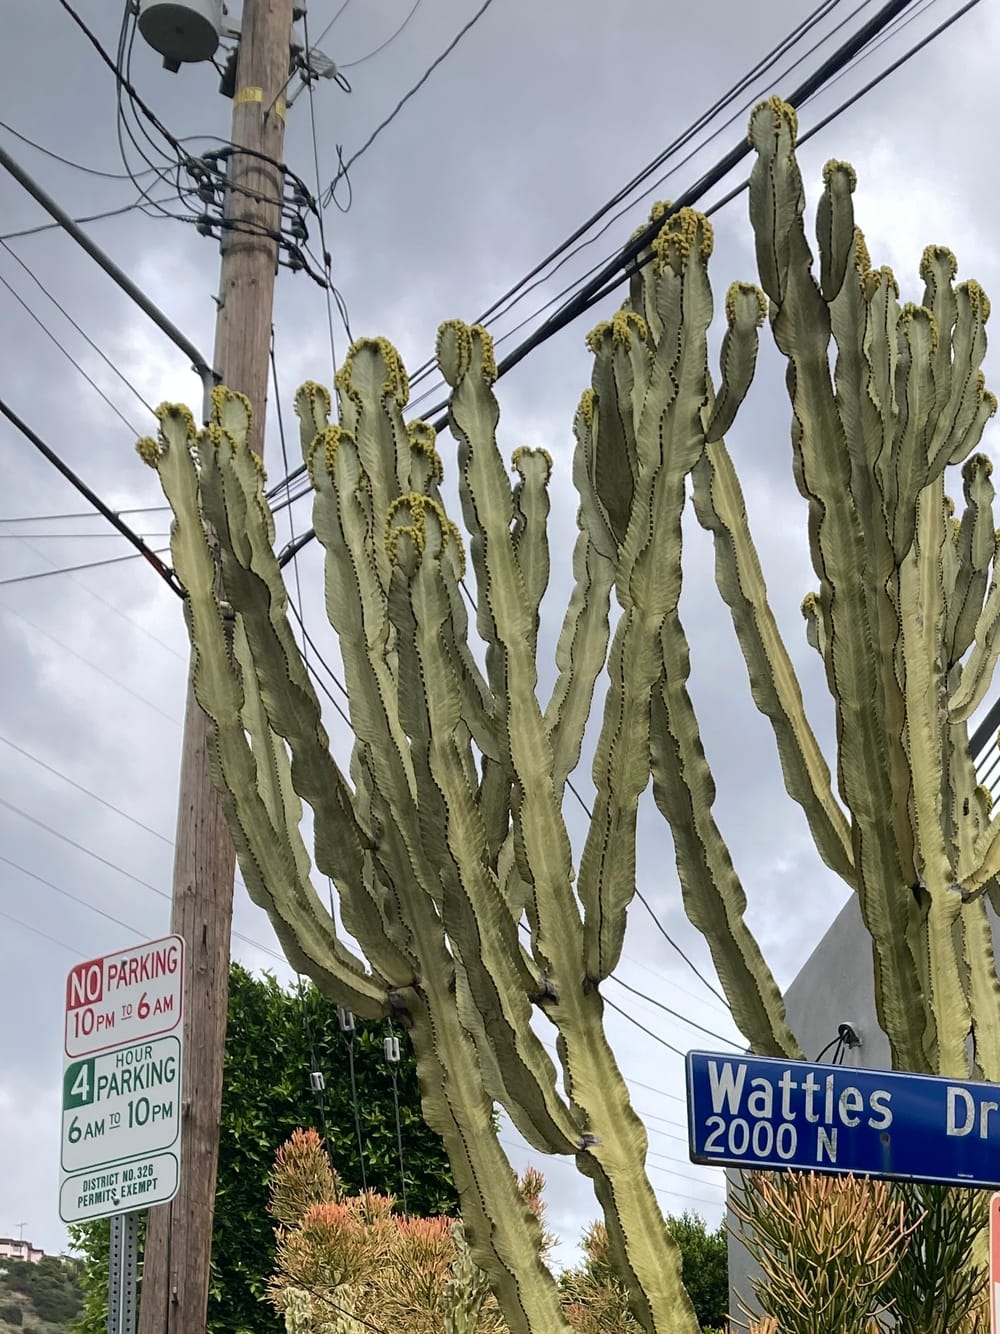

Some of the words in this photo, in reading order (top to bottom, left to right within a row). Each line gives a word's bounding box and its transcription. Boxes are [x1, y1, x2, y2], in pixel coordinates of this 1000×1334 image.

[71, 965, 101, 1006] NO
[107, 946, 177, 992] PARKING
[121, 1003, 133, 1020] TO
[115, 1045, 153, 1069] HOUR
[70, 1063, 90, 1101] 4
[97, 1056, 176, 1102] PARKING
[707, 1060, 894, 1130] Wattles
[946, 1086, 999, 1139] Dr
[109, 1112, 121, 1130] TO
[703, 1115, 798, 1160] 2000
[816, 1127, 838, 1163] N
[77, 1188, 117, 1209] PERMITS
[120, 1177, 158, 1199] EXEMPT
[82, 1172, 120, 1193] DISTRICT
